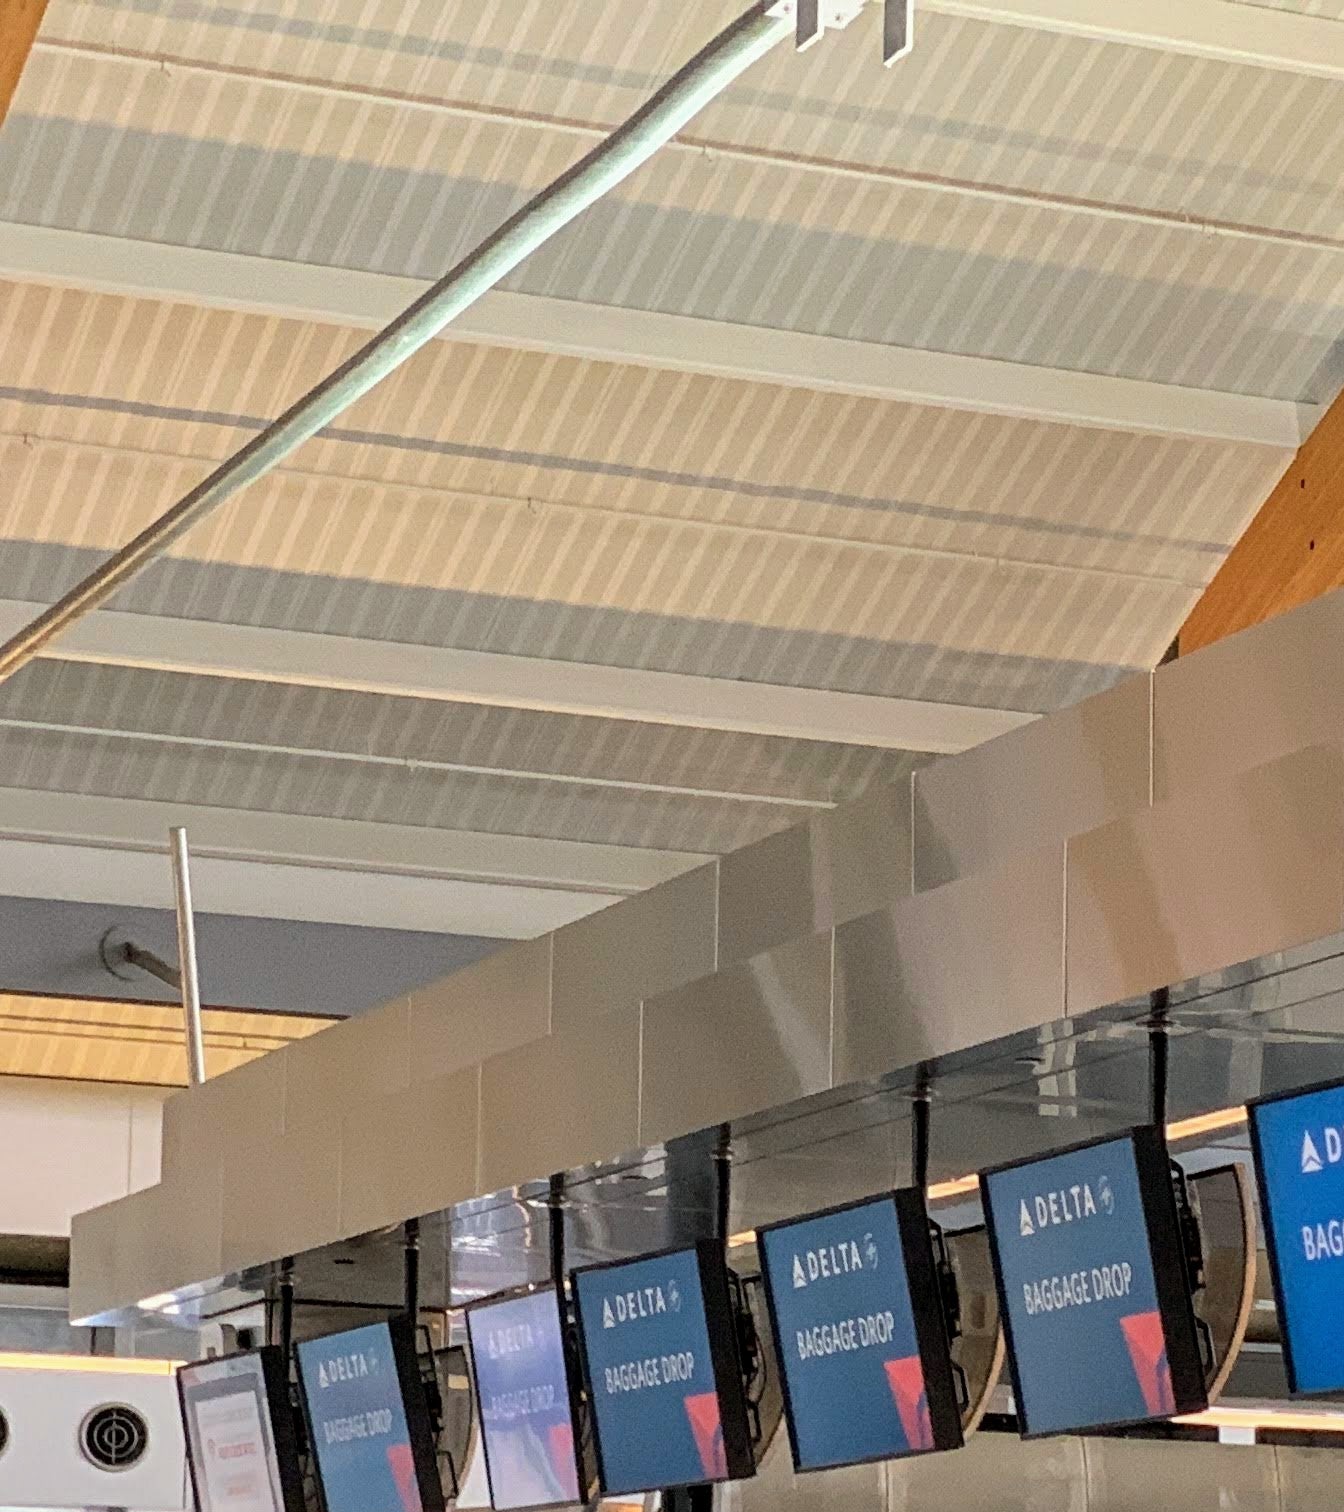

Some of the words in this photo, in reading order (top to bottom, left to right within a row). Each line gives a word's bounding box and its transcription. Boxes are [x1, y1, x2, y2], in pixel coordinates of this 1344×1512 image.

[1034, 1184, 1097, 1228] DELTA
[808, 1241, 862, 1280] DELTA
[613, 1290, 666, 1323] DELTA
[1023, 1270, 1091, 1315] BAGGAGE
[1092, 1261, 1132, 1303] DROP
[797, 1319, 858, 1360] BAGGAGE
[859, 1311, 895, 1349] DROP
[328, 1354, 368, 1382] DELTA
[605, 1357, 659, 1394] BAGGAGE
[660, 1351, 694, 1383] DROP
